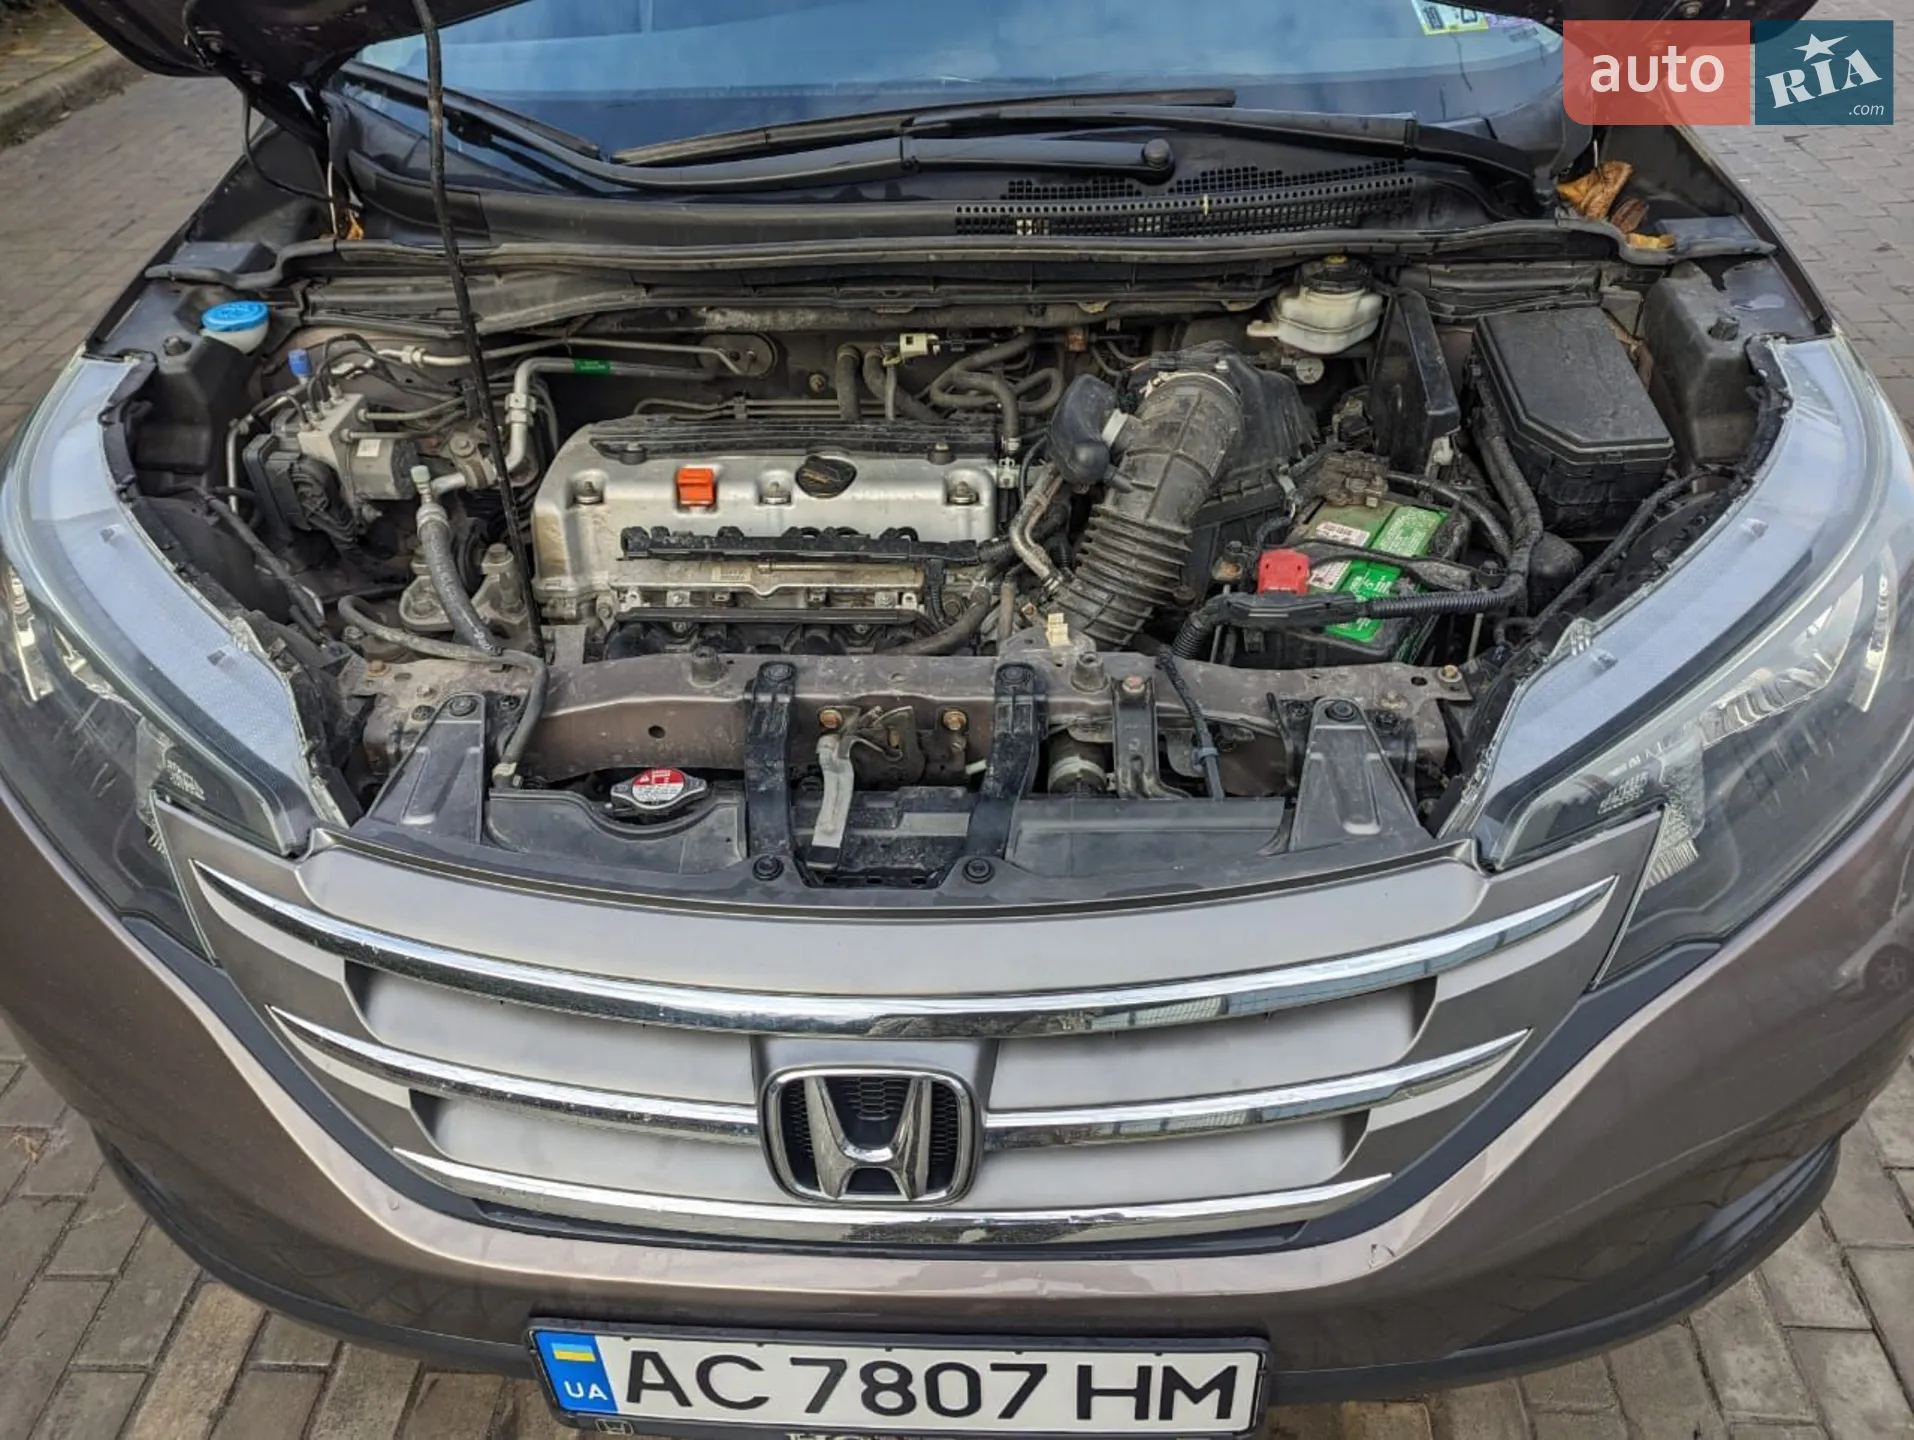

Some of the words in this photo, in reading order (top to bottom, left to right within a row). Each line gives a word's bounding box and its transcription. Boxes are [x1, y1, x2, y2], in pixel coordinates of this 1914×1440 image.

[563, 1380, 608, 1401] UA
[626, 1350, 770, 1410] AC
[789, 1357, 1047, 1418] 7807
[1077, 1364, 1237, 1420] HM
